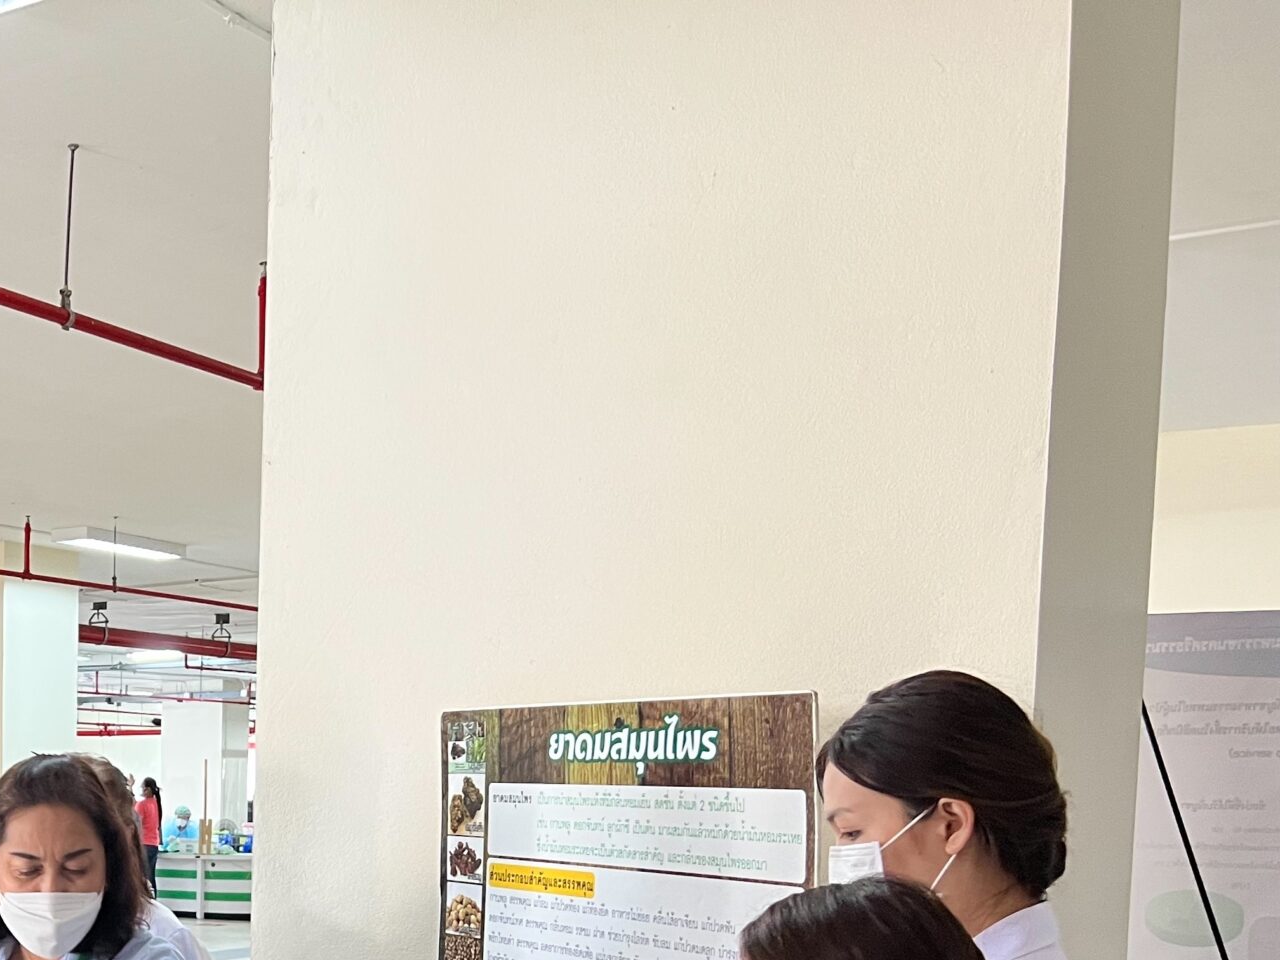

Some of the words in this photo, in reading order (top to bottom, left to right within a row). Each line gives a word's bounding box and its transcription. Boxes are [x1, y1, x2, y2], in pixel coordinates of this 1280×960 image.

[548, 714, 718, 774] ยาดมสมุนไพร
[699, 800, 704, 811] 2
[488, 866, 593, 897] ส่วนประกอบสำคัญและสรรพคุณ
